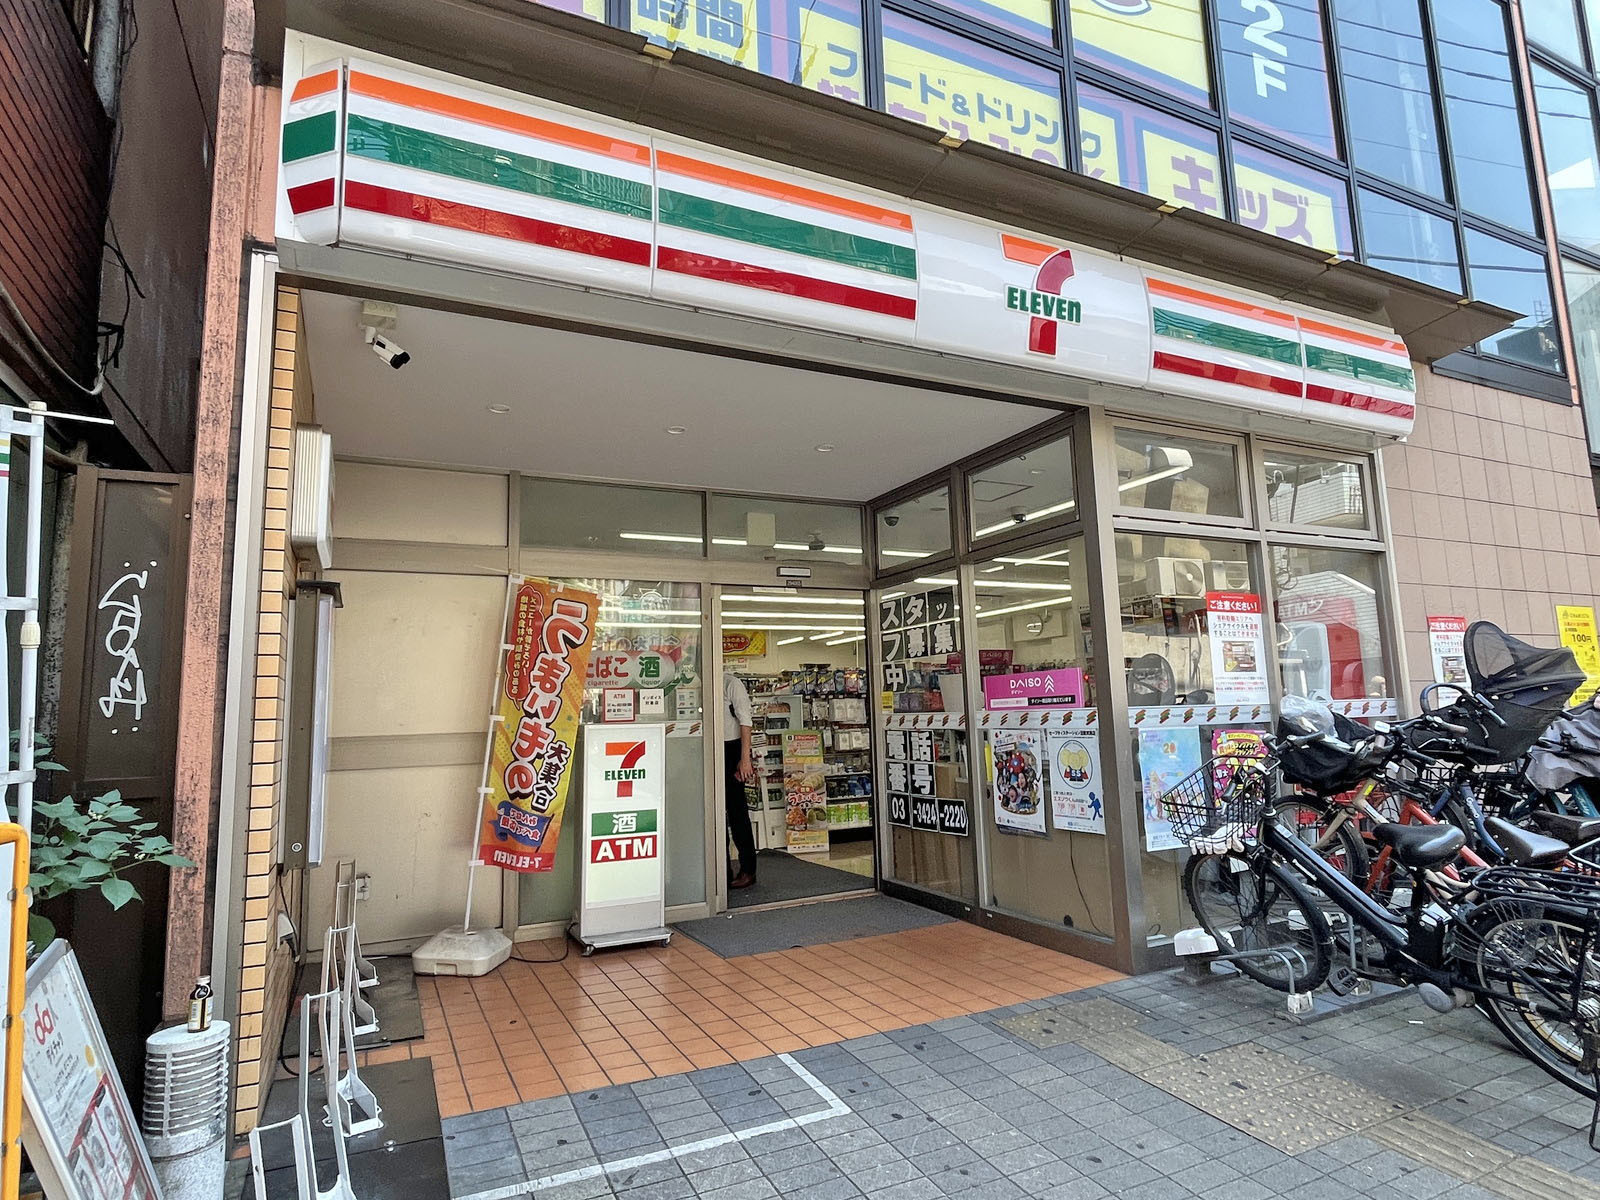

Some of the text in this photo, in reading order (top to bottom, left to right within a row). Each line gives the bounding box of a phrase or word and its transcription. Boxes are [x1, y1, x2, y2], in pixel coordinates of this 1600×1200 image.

[1240, 0, 1288, 98] 2F
[1170, 154, 1313, 247] キッズ
[1209, 600, 1258, 611] ご注意ください!
[638, 655, 661, 679] 酒
[885, 663, 904, 692] 中
[641, 679, 661, 687] liquor
[1010, 677, 1042, 689] DAISO
[612, 812, 638, 834] 酒
[595, 837, 653, 861] ATM
